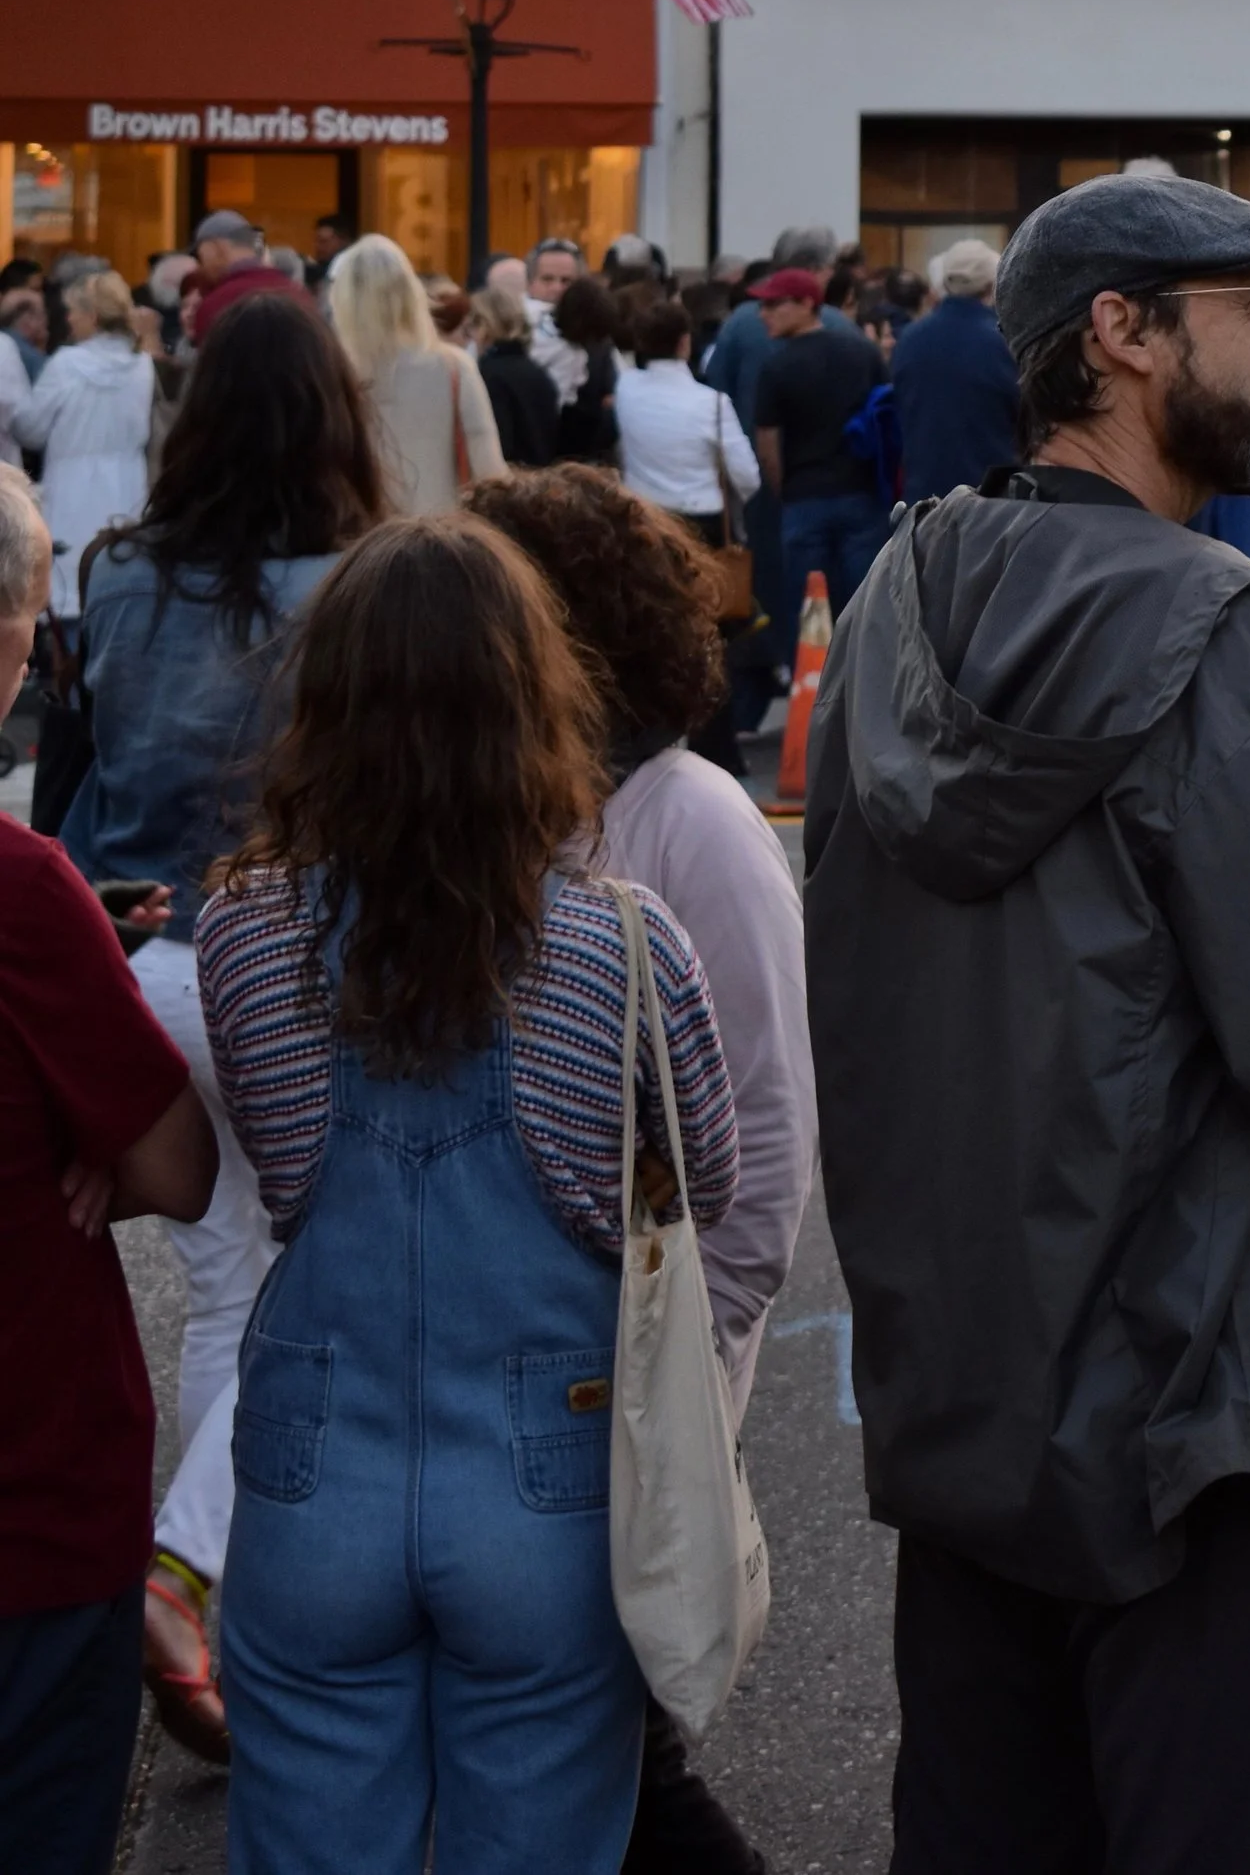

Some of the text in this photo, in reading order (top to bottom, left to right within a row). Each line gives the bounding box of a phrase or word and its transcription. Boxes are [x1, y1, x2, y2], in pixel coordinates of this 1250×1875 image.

[88, 103, 450, 144] Brown Harris Stevens
